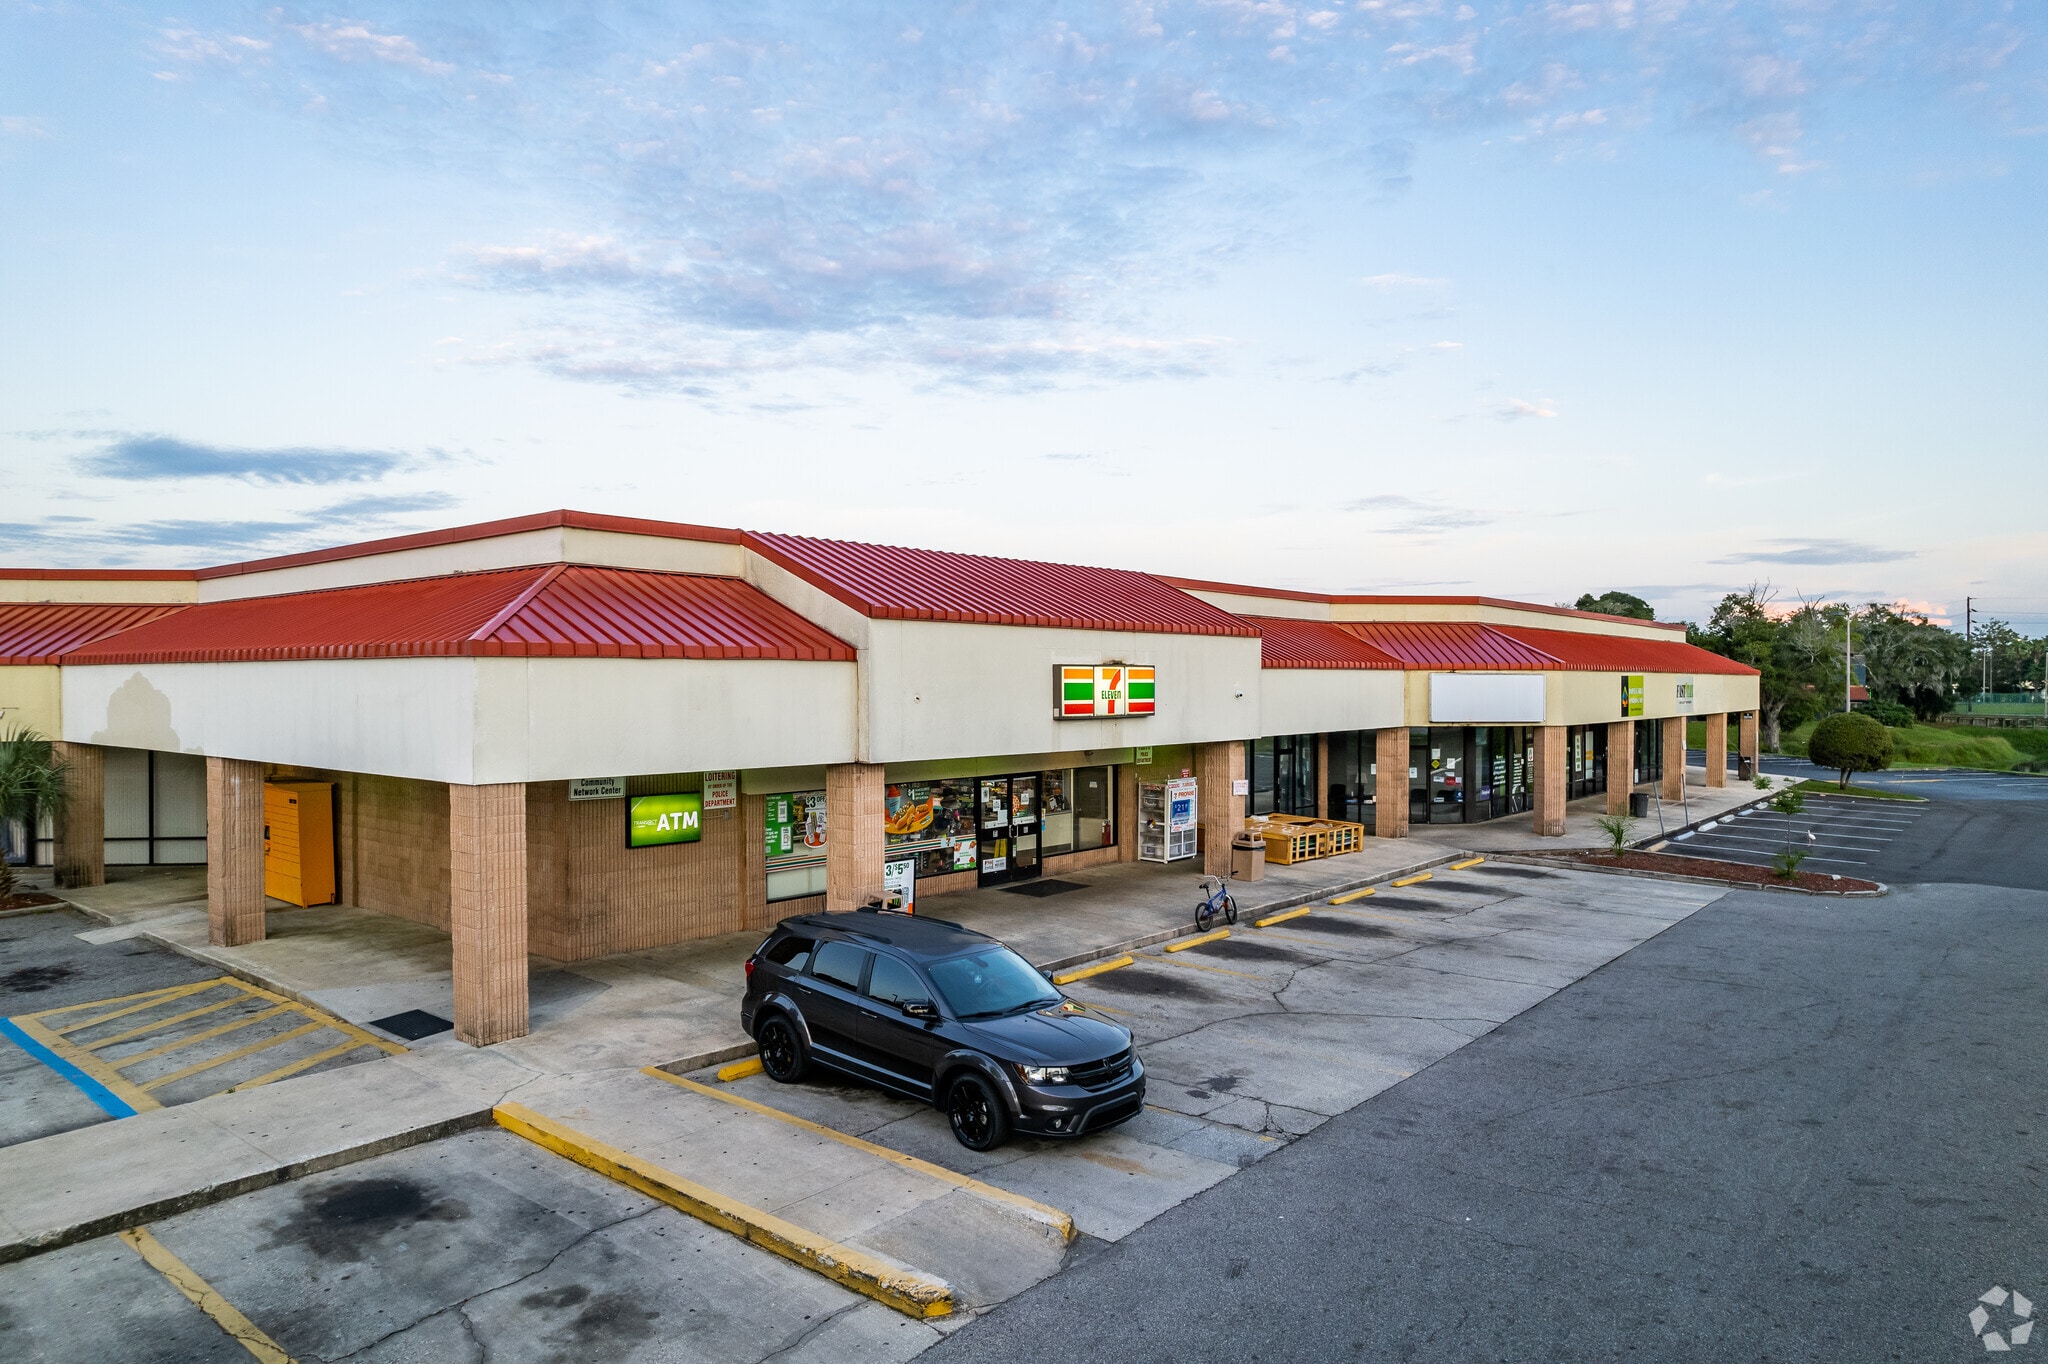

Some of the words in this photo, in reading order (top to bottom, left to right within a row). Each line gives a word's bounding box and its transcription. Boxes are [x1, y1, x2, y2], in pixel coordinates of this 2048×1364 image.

[1102, 669, 1121, 714] 7
[705, 771, 735, 781] LOITERING
[581, 778, 614, 786] Community
[573, 787, 599, 796] Network
[601, 786, 621, 795] Center
[712, 790, 729, 798] POLICE
[705, 798, 735, 807] DEPARTMENT
[806, 796, 816, 808] $3
[656, 811, 699, 832] ATM
